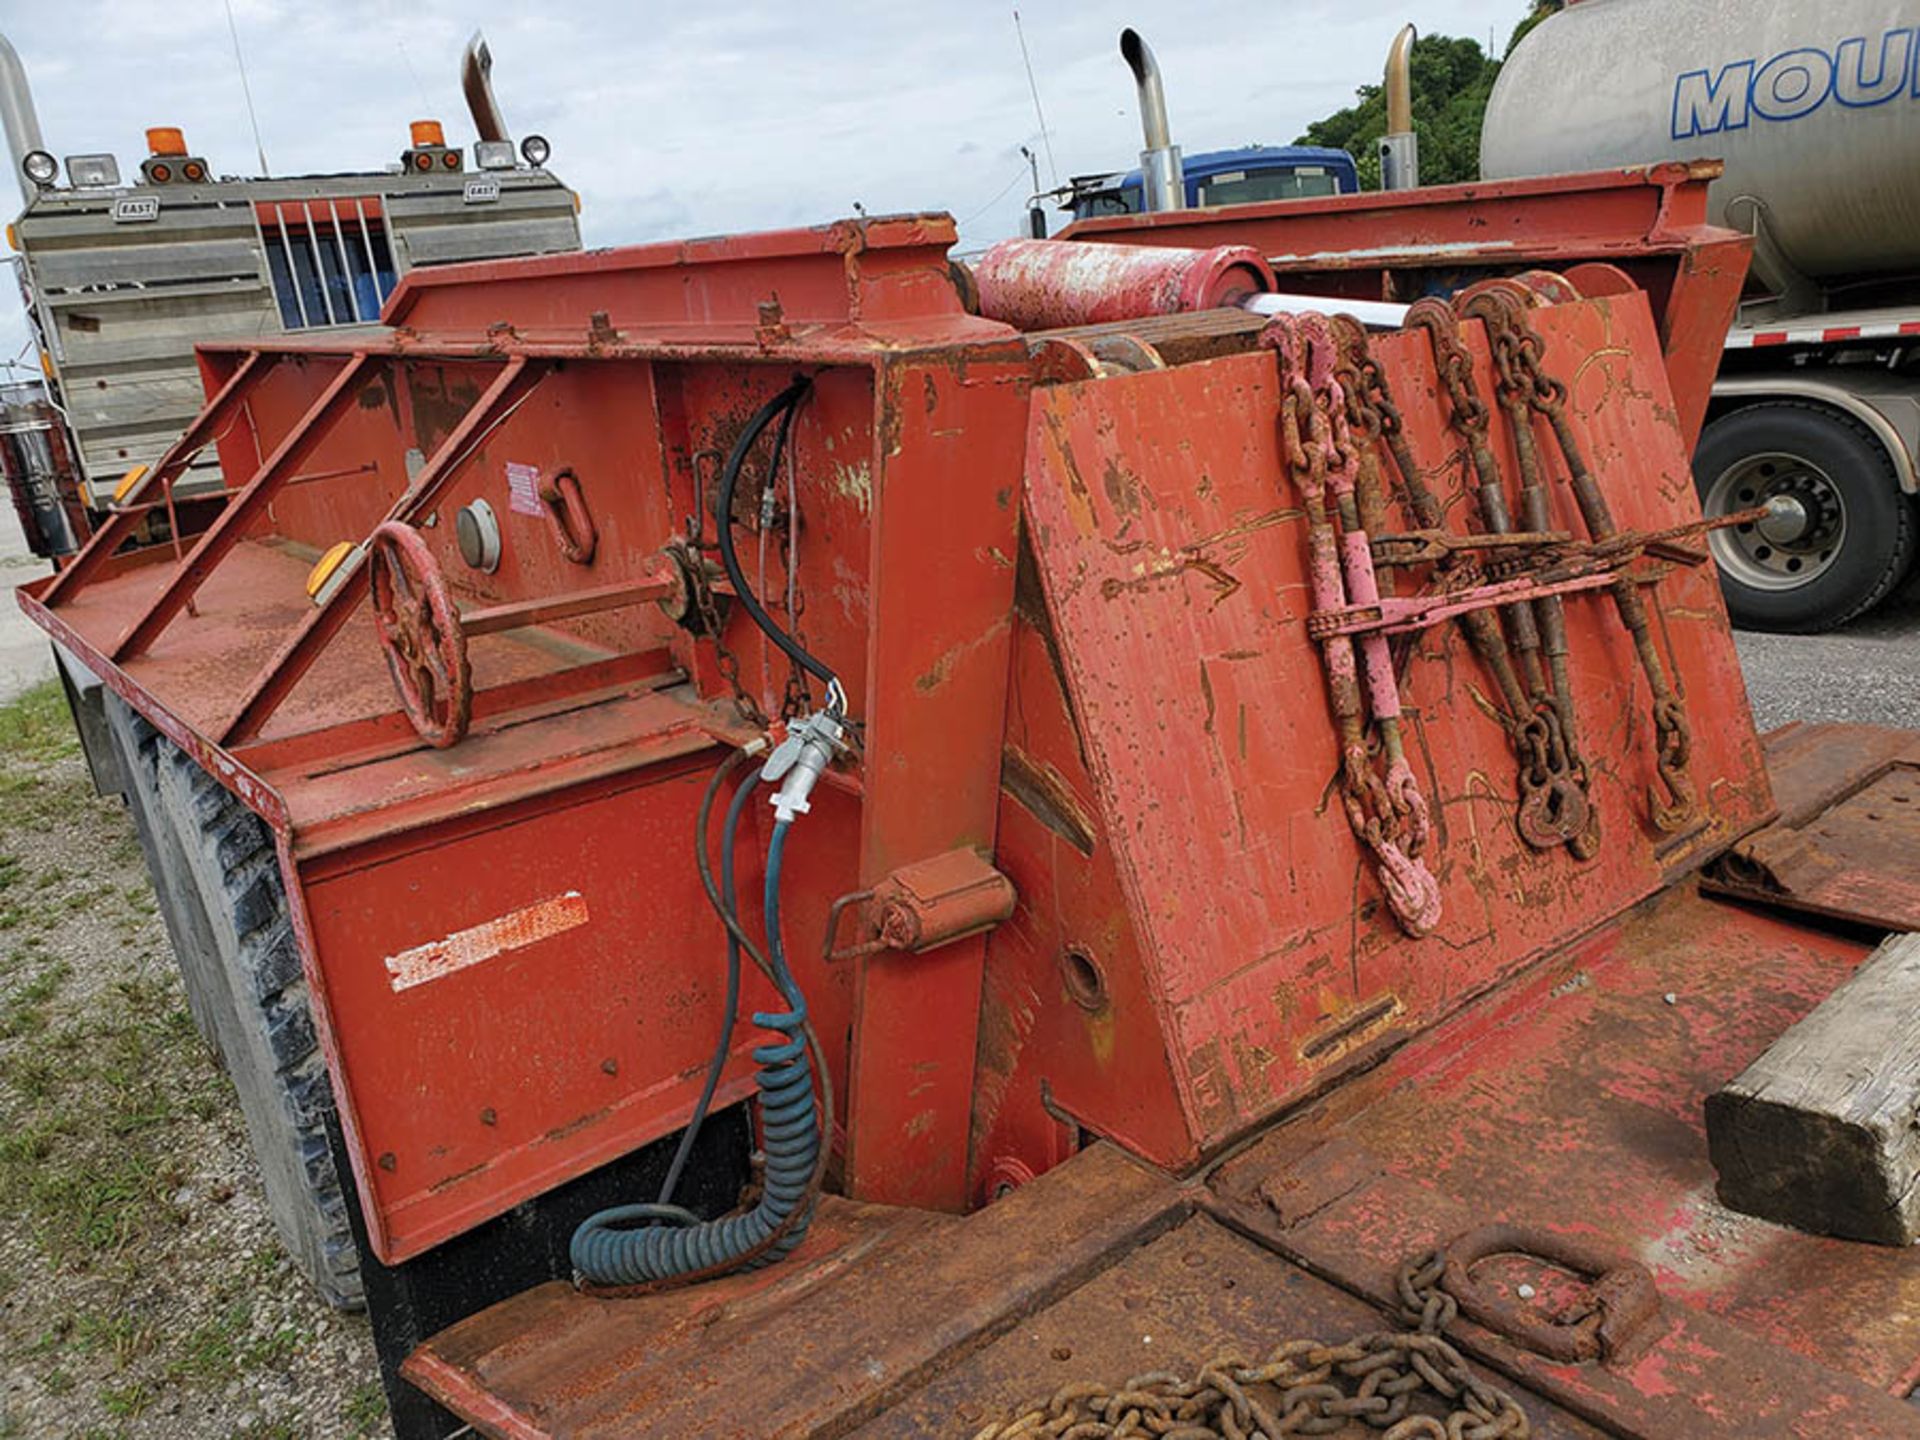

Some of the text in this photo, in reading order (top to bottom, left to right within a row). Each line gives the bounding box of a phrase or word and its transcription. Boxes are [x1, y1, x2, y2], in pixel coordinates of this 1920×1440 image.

[1672, 27, 1920, 140] MOU
[470, 186, 495, 196] EAST
[121, 202, 152, 215] EAST
